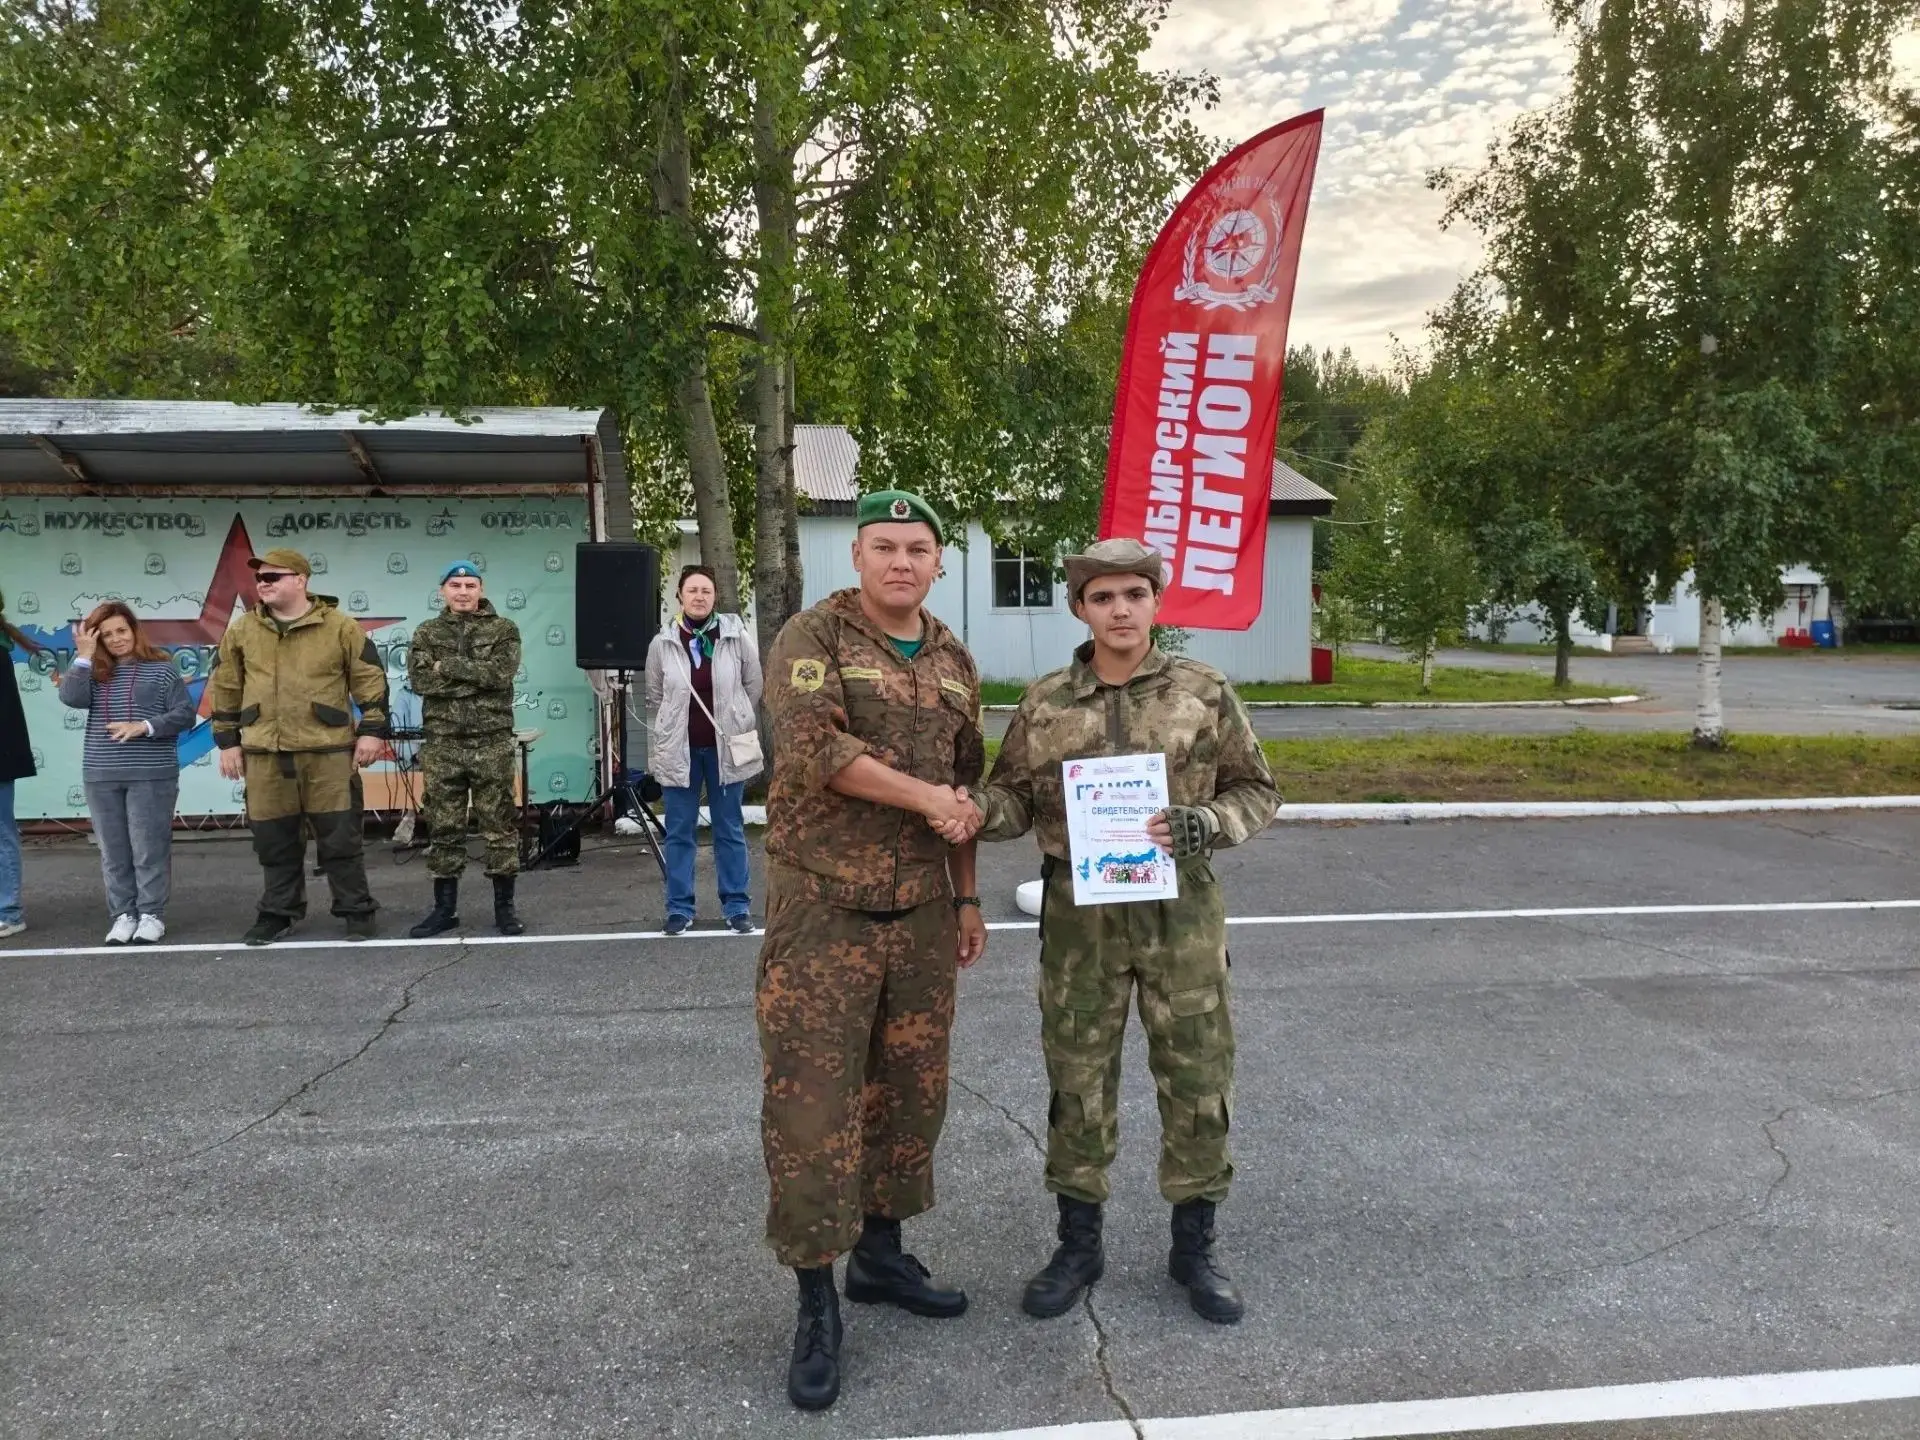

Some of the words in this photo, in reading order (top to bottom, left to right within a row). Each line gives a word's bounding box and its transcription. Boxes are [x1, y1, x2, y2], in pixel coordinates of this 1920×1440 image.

[44, 511, 192, 530] МУЖЕСТВО
[281, 511, 411, 533] ДОБЛЕСТЬ
[481, 511, 572, 529] ОТВАГА
[1143, 331, 1200, 587] ИБИРСКИЙ
[1181, 333, 1258, 596] ЛЕГИОН
[1091, 806, 1160, 816] СВИДЕТЕЛЬСТВО
